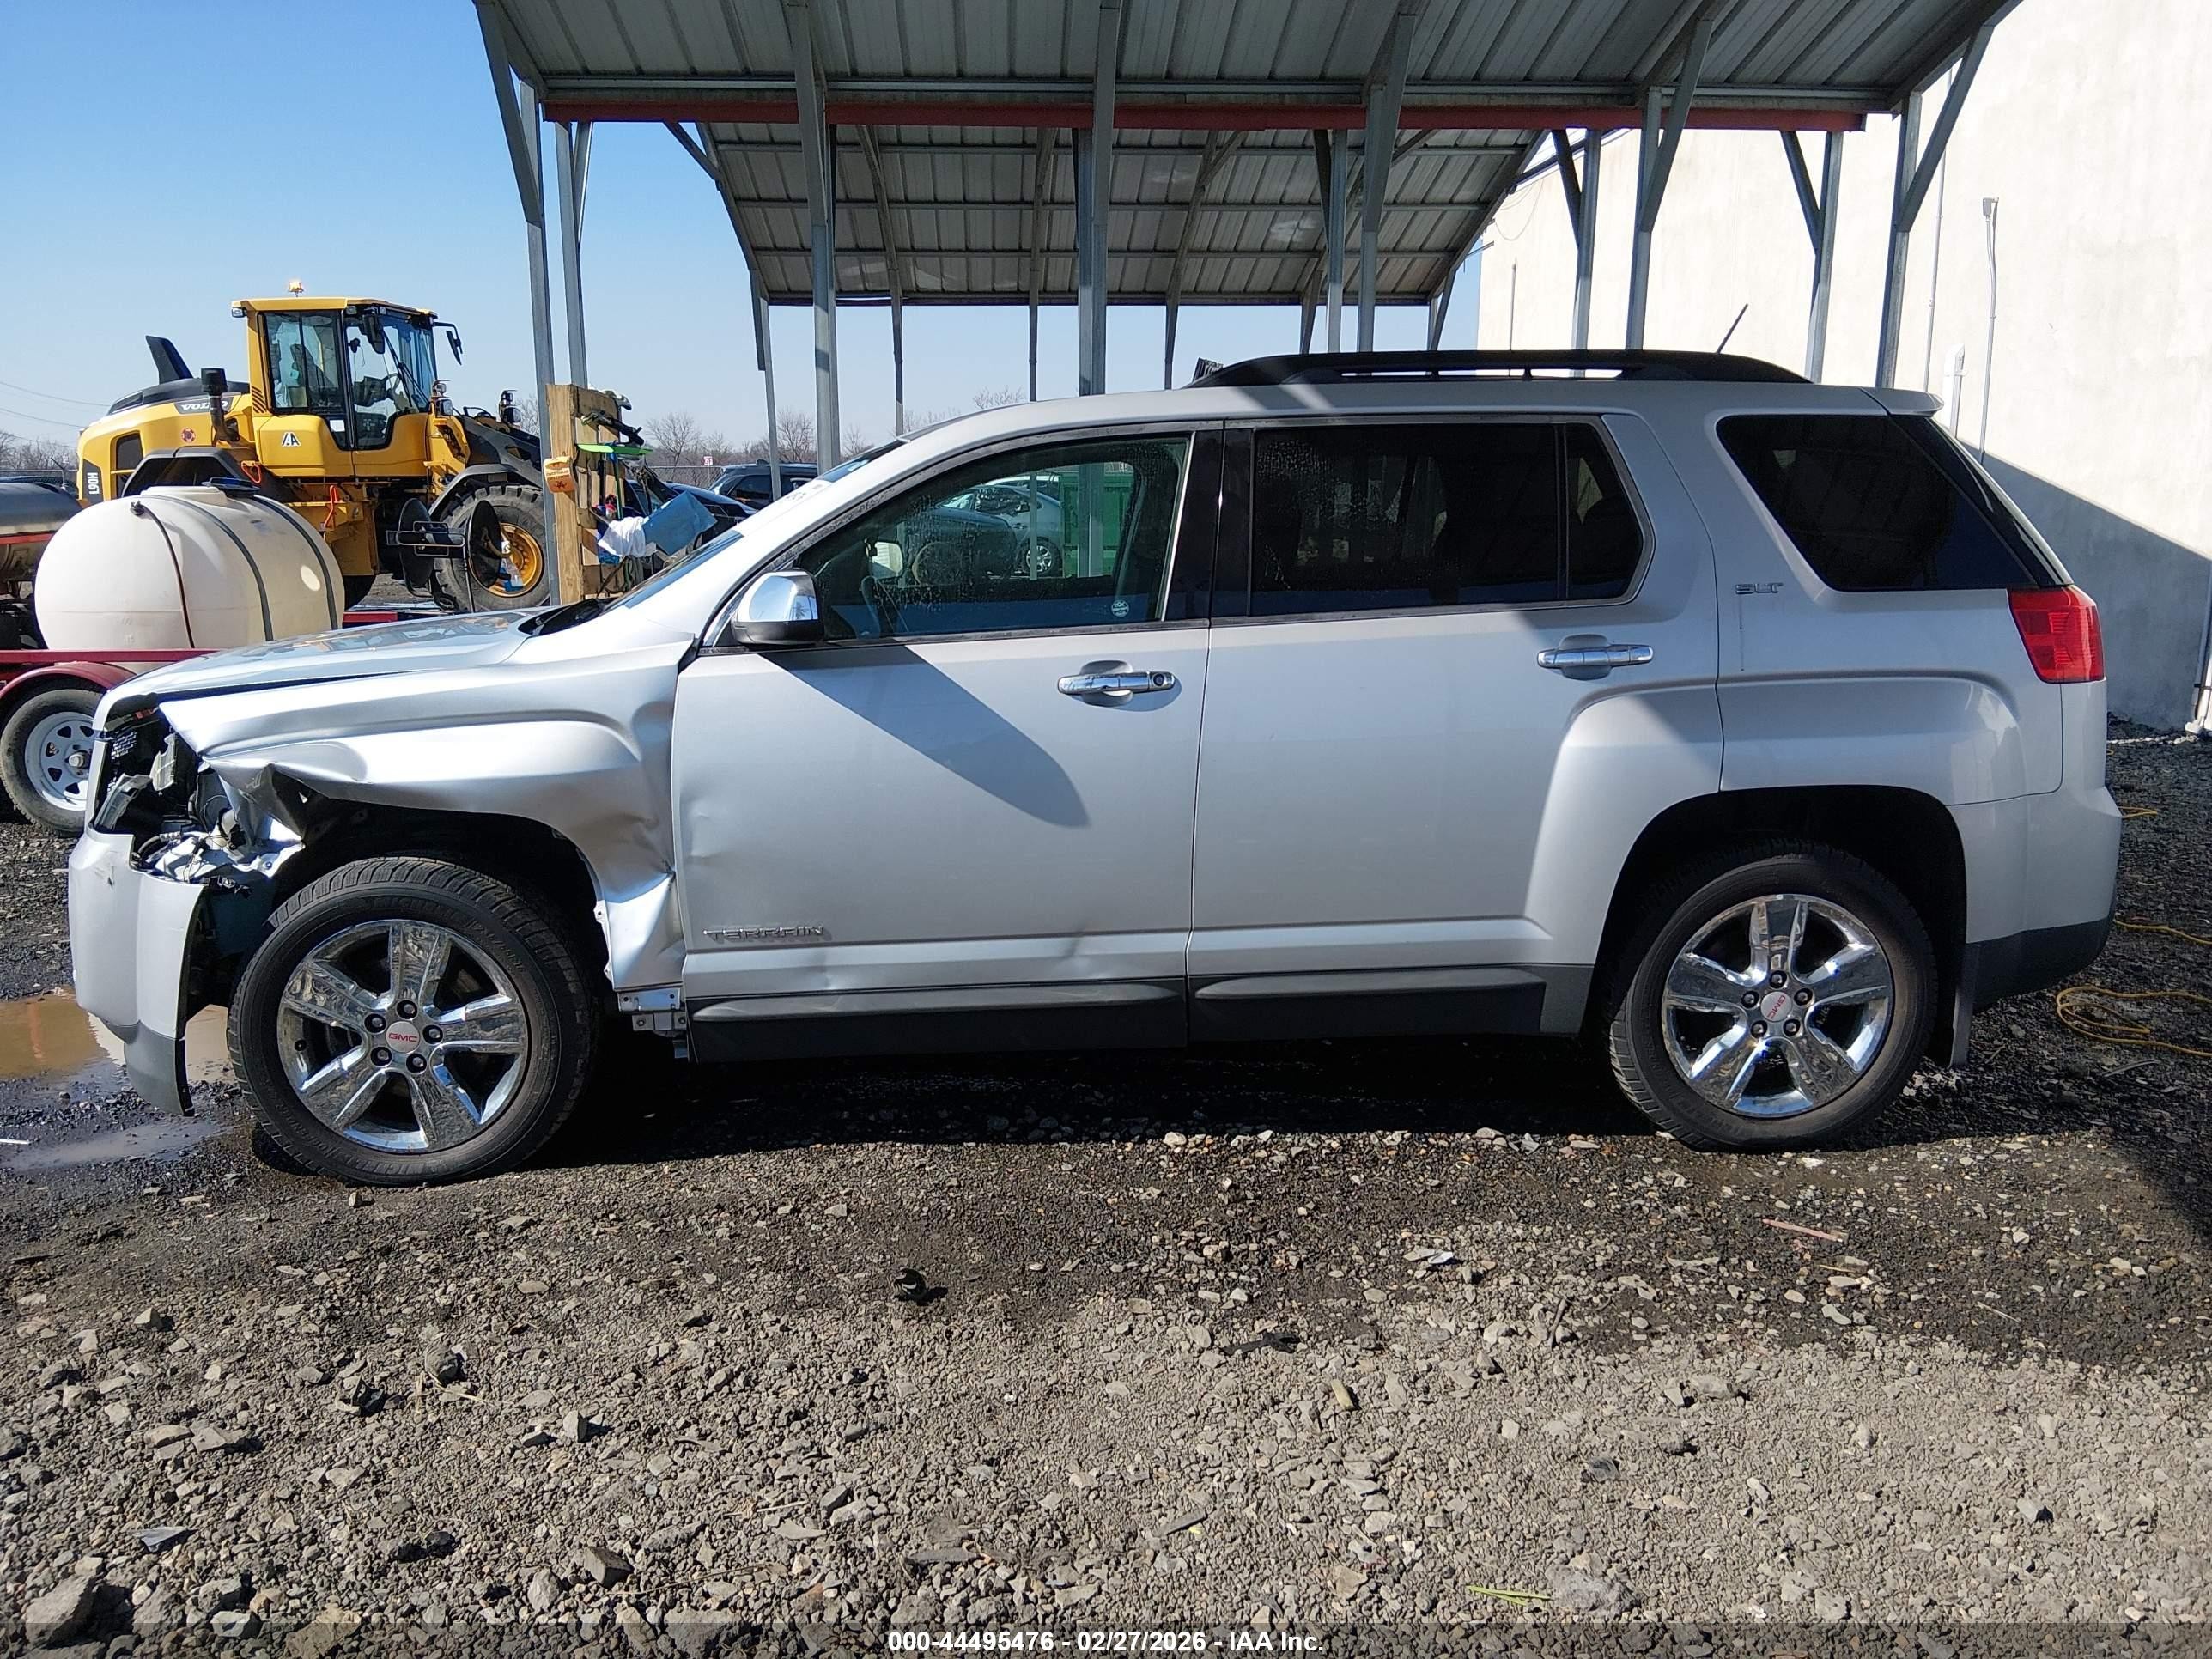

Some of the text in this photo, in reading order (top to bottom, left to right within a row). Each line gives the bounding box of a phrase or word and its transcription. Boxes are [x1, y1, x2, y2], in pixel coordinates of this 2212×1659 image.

[180, 400, 228, 411] VOLO
[87, 472, 100, 495] L90H
[1735, 582, 1784, 595] SLT
[702, 925, 825, 942] TERRAIN
[1765, 994, 1787, 1020] GMC
[388, 1032, 419, 1043] GMC
